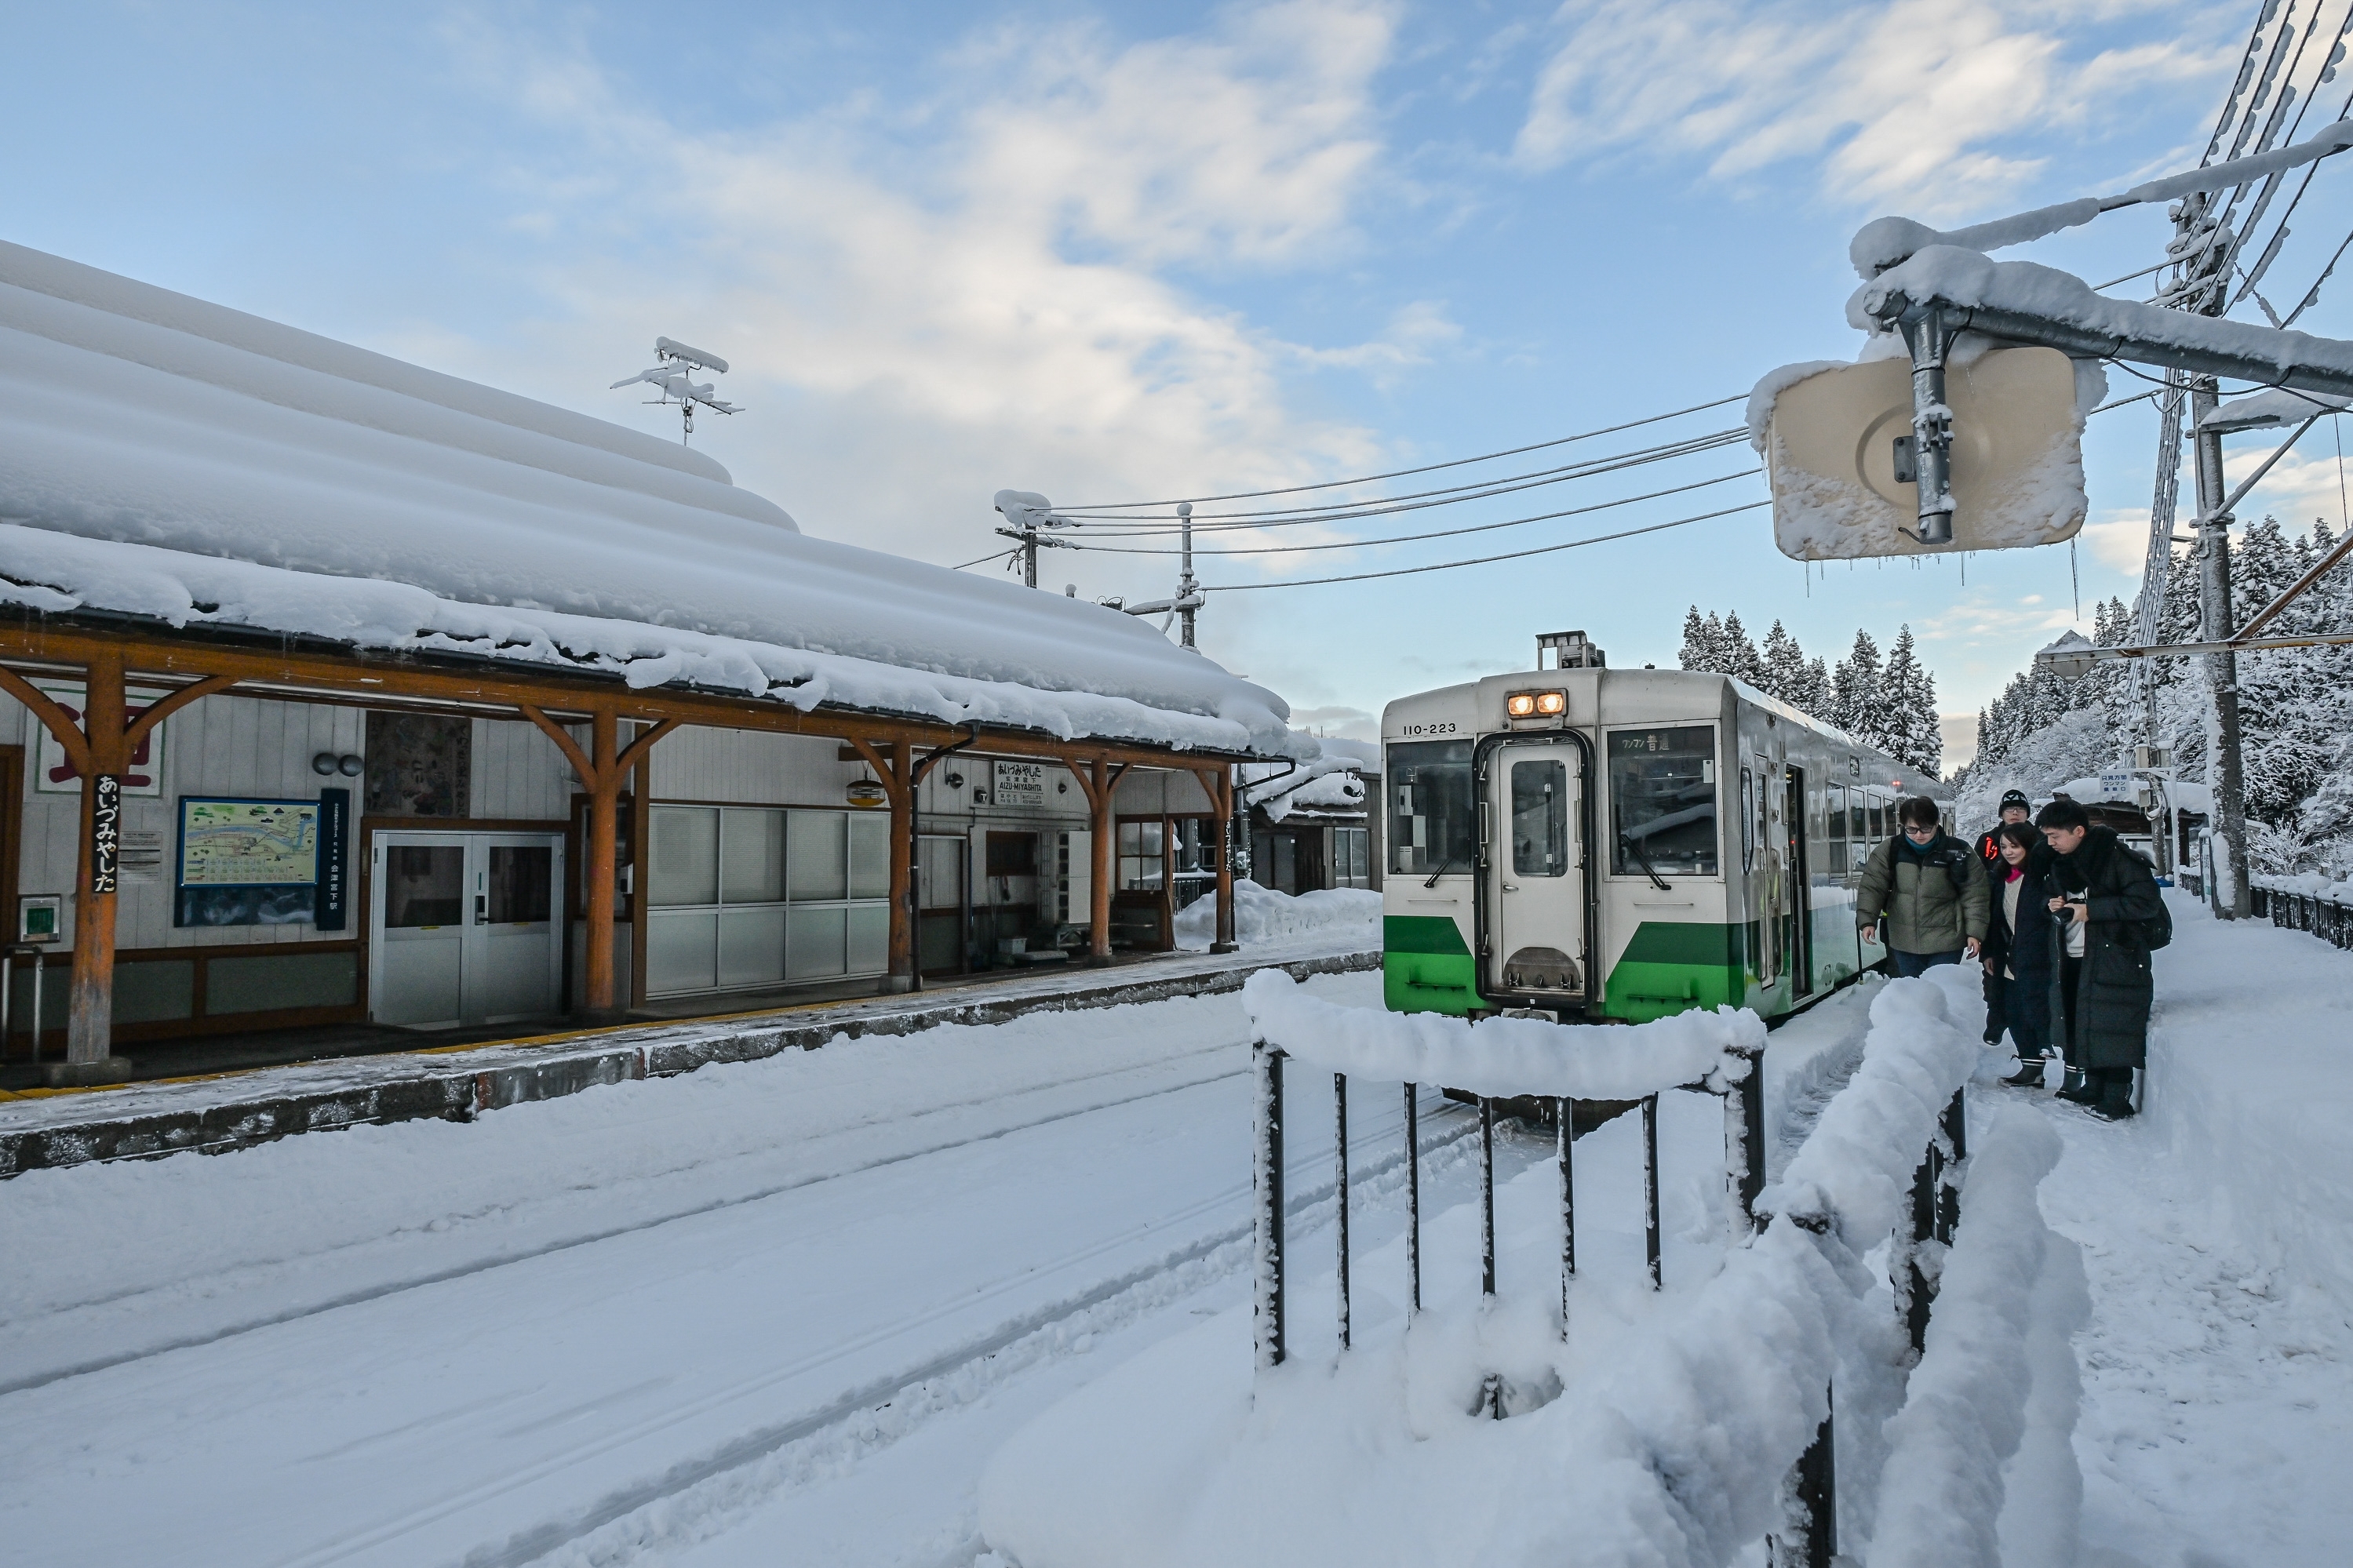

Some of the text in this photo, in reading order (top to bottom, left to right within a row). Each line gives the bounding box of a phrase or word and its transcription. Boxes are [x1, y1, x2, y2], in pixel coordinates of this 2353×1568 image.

[1404, 722, 1456, 735] 110-223
[1622, 733, 1670, 751] ワンマン 普通
[998, 763, 1041, 777] あいづみやした
[999, 782, 1042, 791] AIZU-MIYASHITA
[95, 776, 118, 892] あいづみやした
[330, 864, 338, 910] 会津宮下駅
